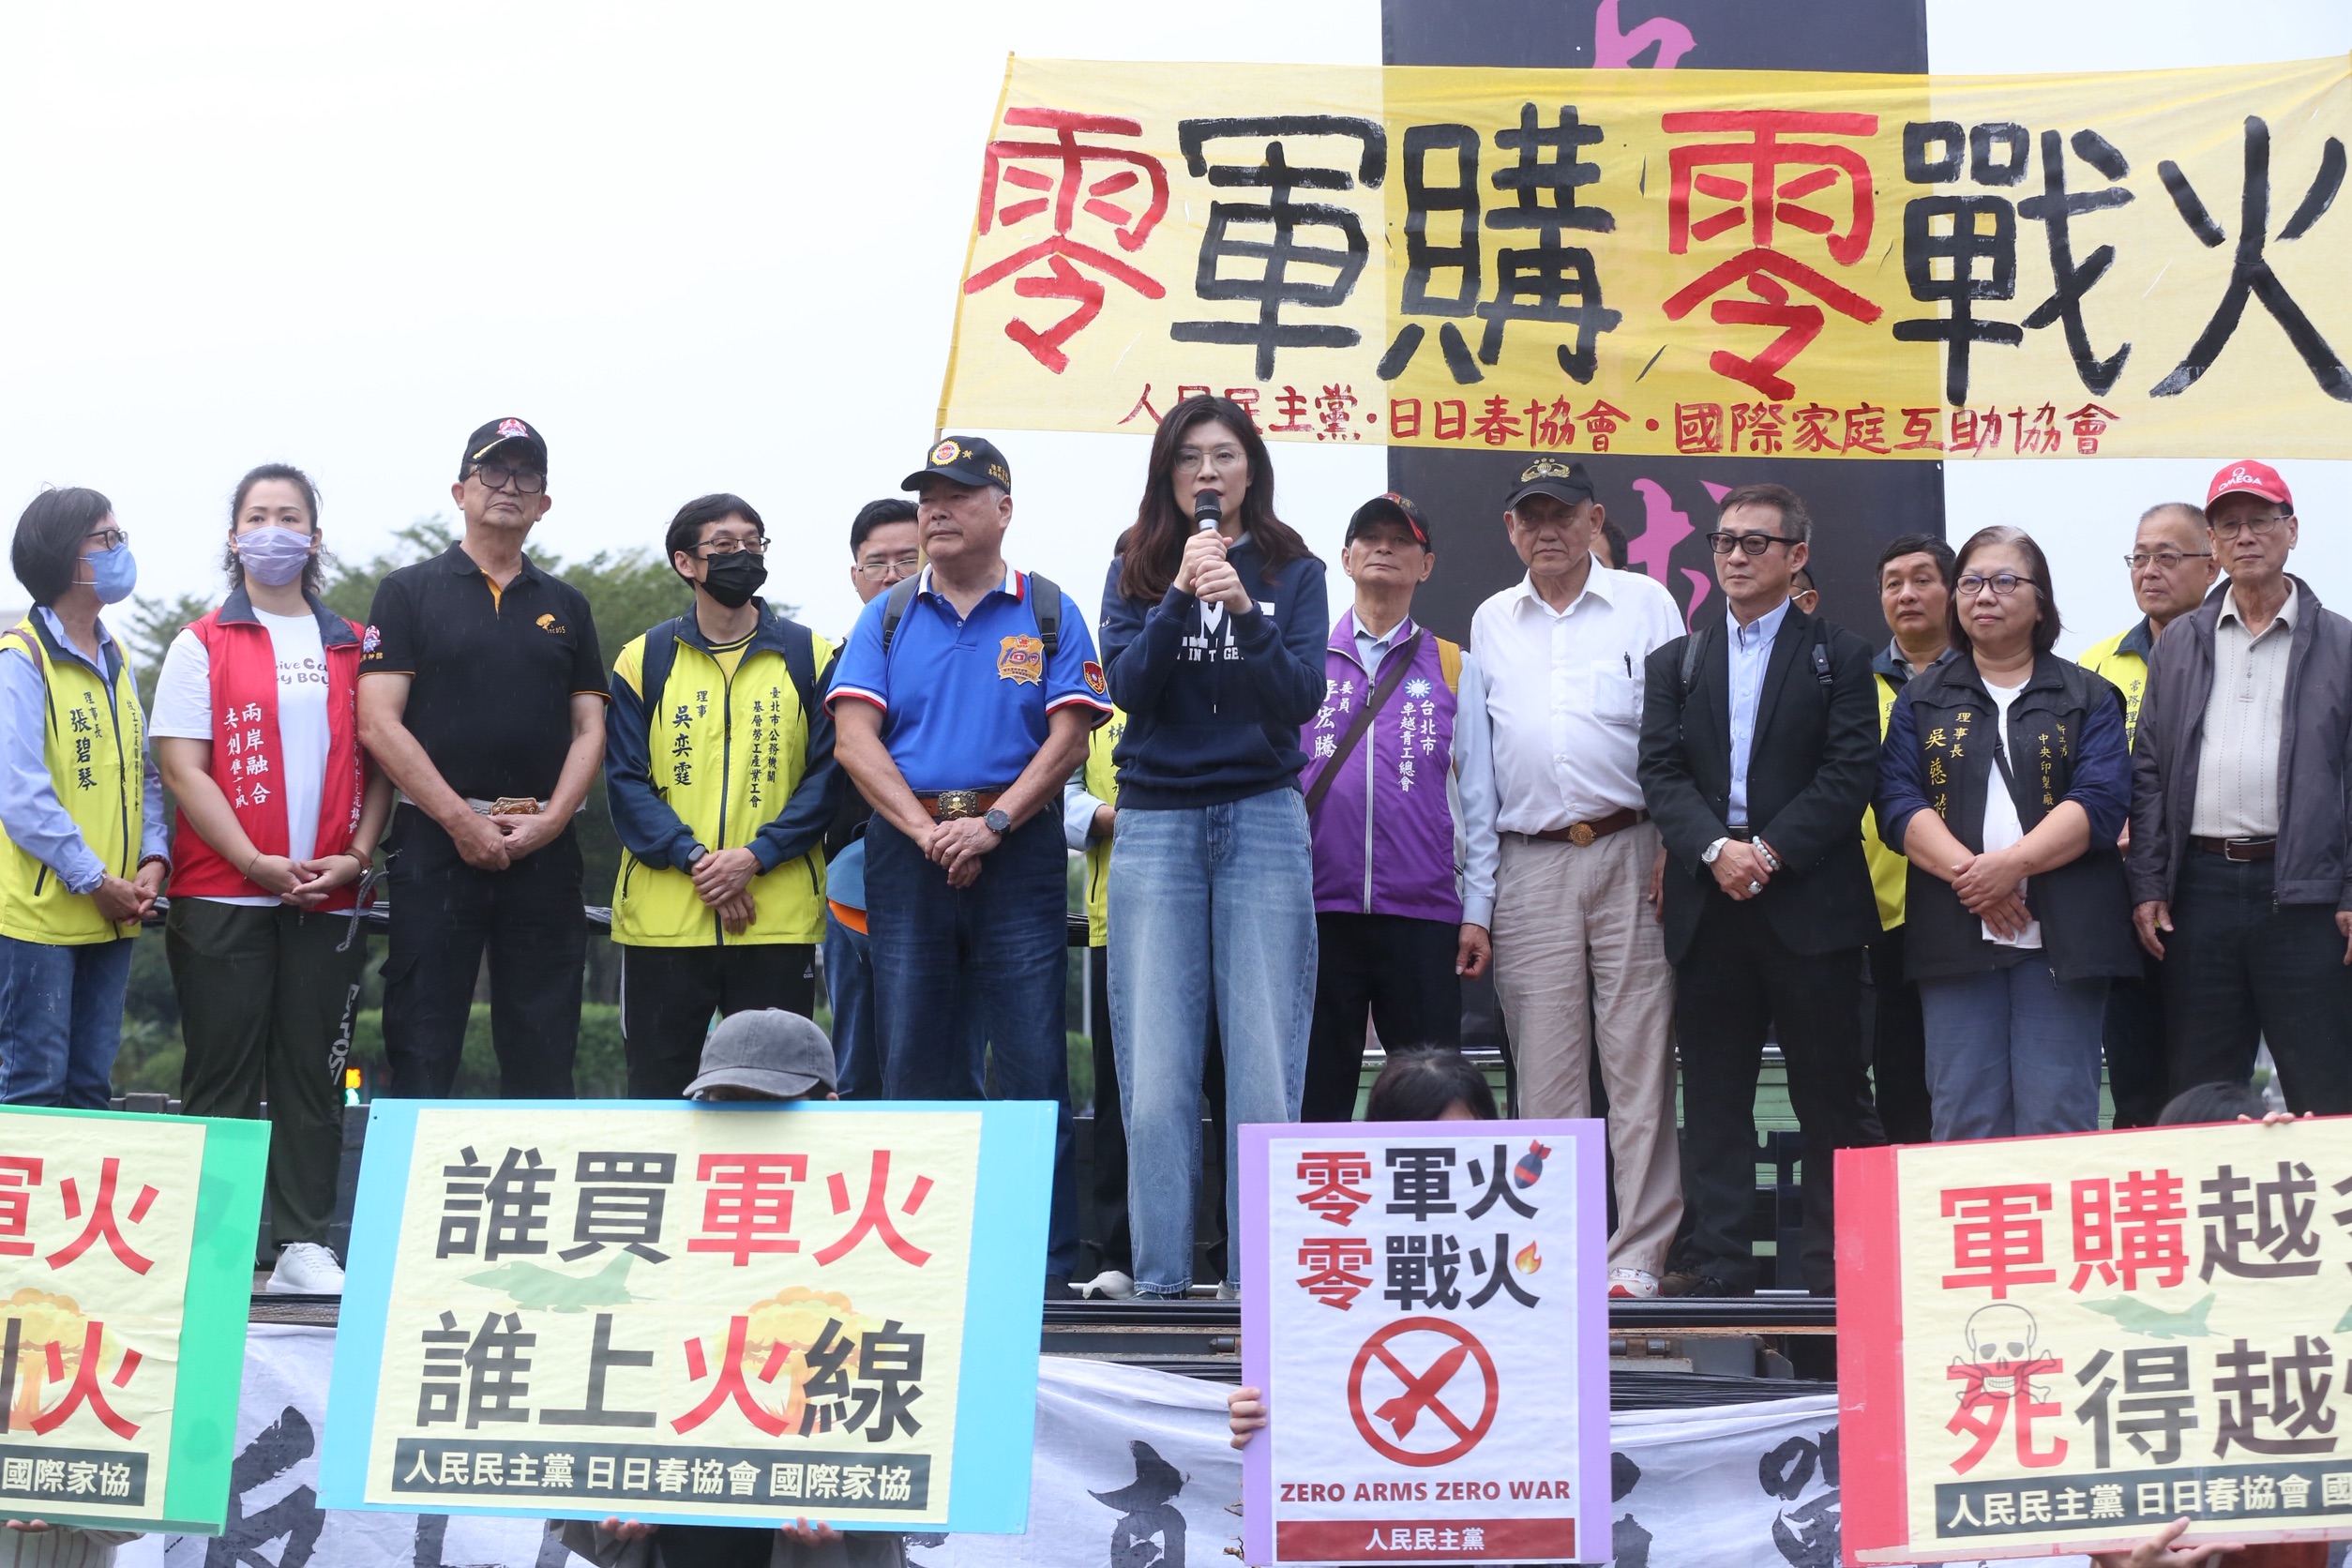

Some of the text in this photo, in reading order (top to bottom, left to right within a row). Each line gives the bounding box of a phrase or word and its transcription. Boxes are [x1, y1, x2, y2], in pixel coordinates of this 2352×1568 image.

[963, 103, 2352, 405] 零軍購零戰火
[2219, 475, 2262, 490] OMEGA
[83, 691, 103, 738] 理事長
[696, 690, 708, 717] 理事
[767, 686, 781, 783] 臺北市公務機關
[1338, 680, 1353, 713] 委員
[1420, 700, 1437, 756] 台北市
[1950, 713, 1971, 758] 理事長
[69, 708, 98, 791] 張碧琴
[242, 702, 271, 805] 兩岸融合
[671, 705, 692, 785] 吳奕霆
[749, 701, 764, 807] 基層勞工產業工會
[1398, 701, 1417, 792] 卓越青工總會
[2038, 733, 2054, 813] 中央印製廠
[435, 1145, 934, 1267] 誰買軍火
[1295, 1144, 1541, 1228] 零軍火
[1940, 1161, 2352, 1300] 軍購越
[1296, 1233, 1542, 1312] 零戰火
[415, 1310, 926, 1442] 誰上火線
[1945, 1335, 2352, 1476] 死得越
[2, 1456, 130, 1498] 國際家協
[403, 1450, 912, 1502] 人民民主黨 日日春協會 國際家協
[1280, 1481, 1570, 1502] ZERO ARMS ZERO WAR
[1947, 1484, 2124, 1530] 人民民主黨
[2137, 1473, 2311, 1515] 日日春協會
[1364, 1528, 1485, 1552] 人民民主黨
